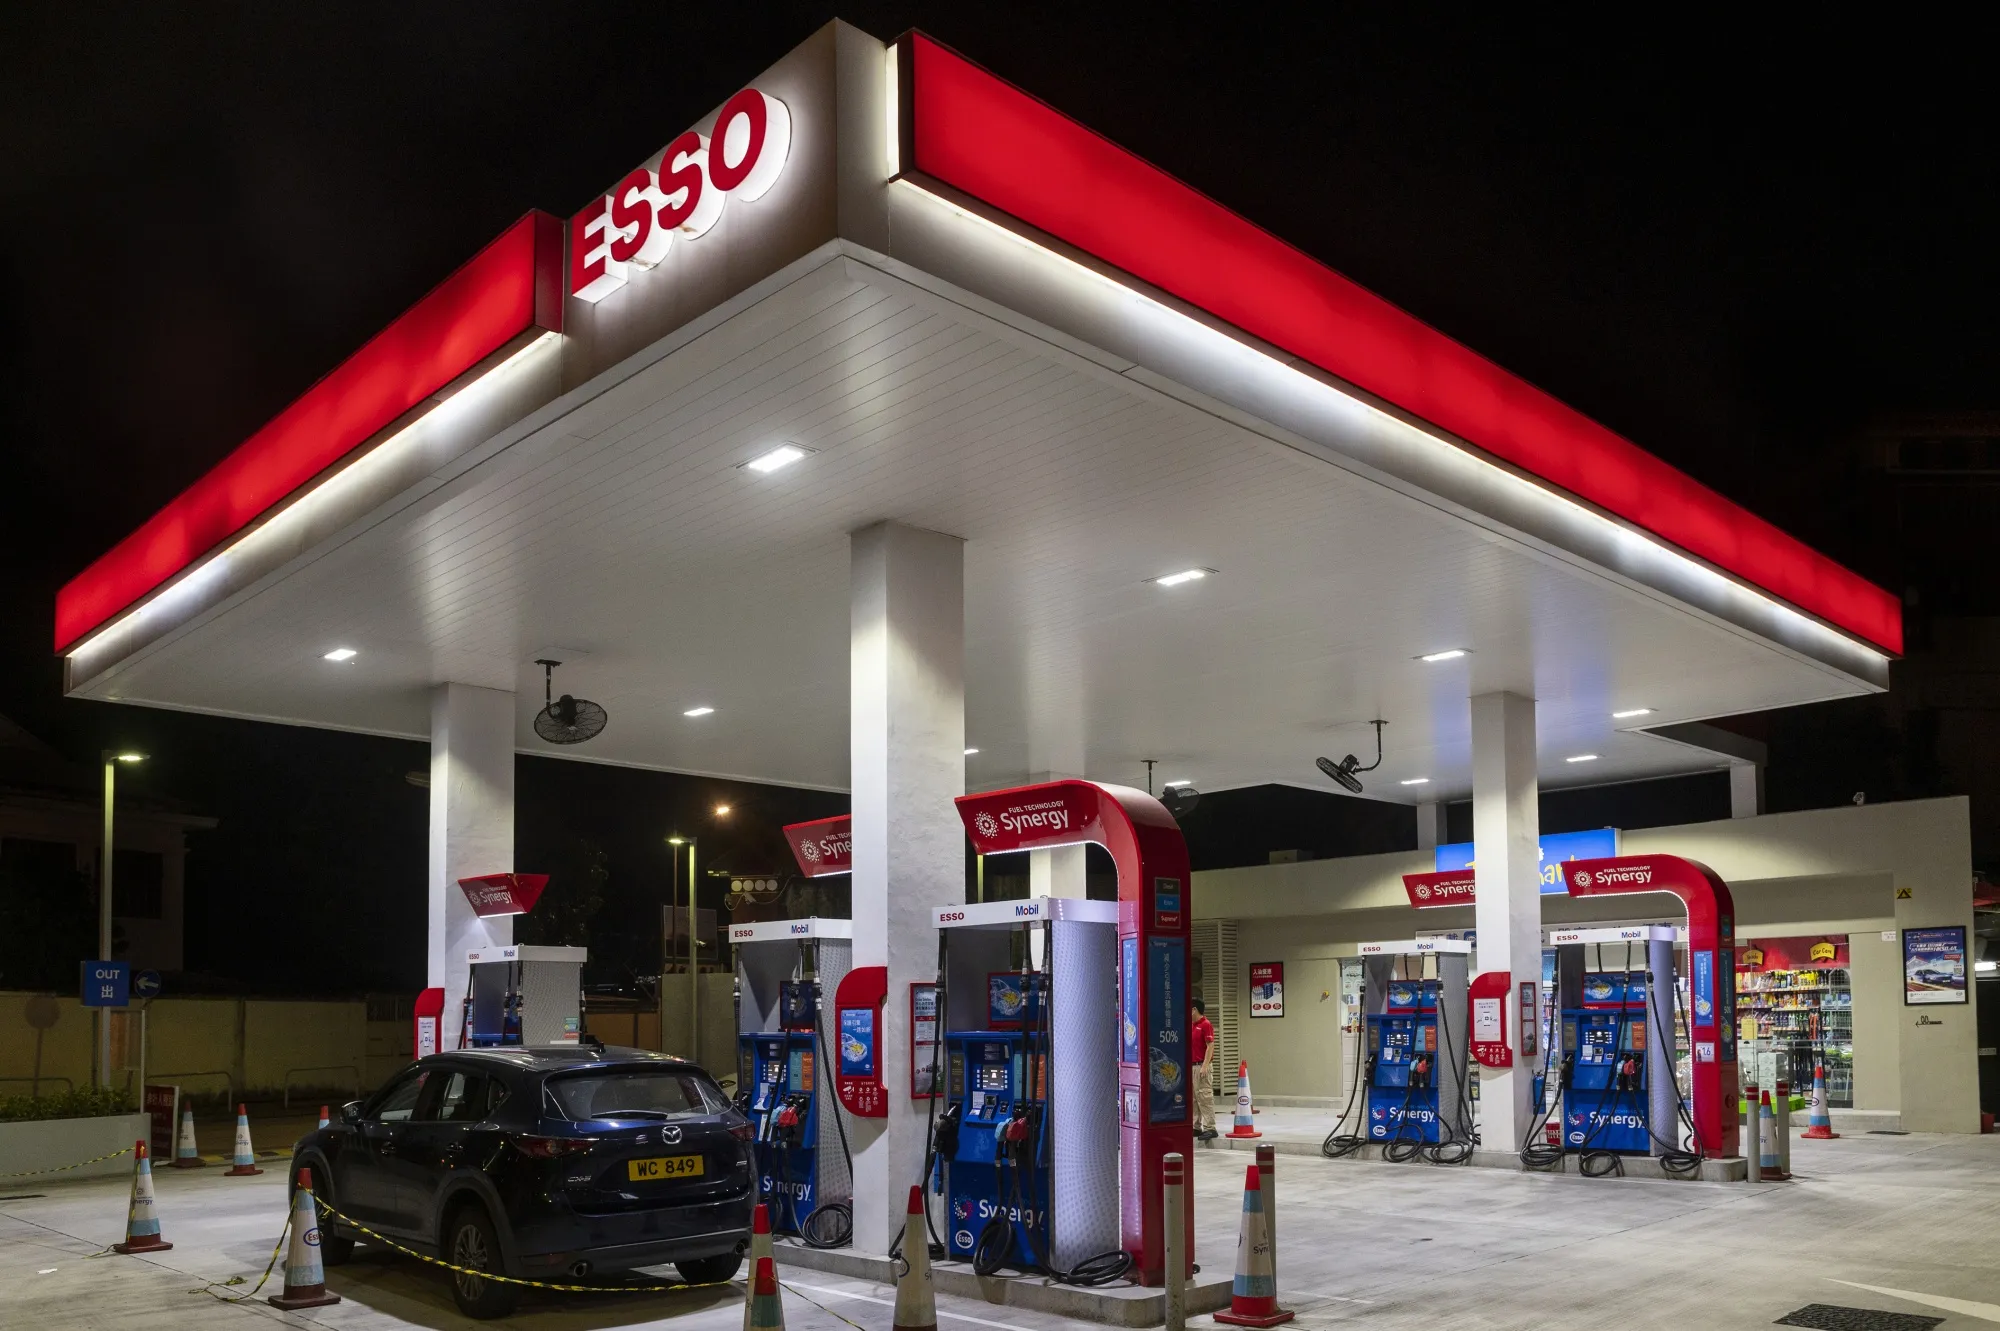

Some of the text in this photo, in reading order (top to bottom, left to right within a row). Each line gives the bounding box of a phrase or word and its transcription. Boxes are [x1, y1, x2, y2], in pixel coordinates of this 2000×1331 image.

[572, 88, 768, 296] ESSO
[1024, 800, 1064, 811] TECHNOLOGY
[1000, 809, 1068, 834] Synergy
[1595, 871, 1652, 885] Synergy
[480, 890, 513, 905] Synergy
[940, 904, 1039, 921] ESSO Mobil
[734, 924, 809, 938] ESSO Mobil
[95, 969, 120, 979] OUT
[101, 985, 113, 999] 出
[1159, 1030, 1179, 1043] 50%
[1389, 1106, 1435, 1122] Synergy
[637, 1159, 695, 1176] WC 849
[958, 1234, 971, 1244] Esso
